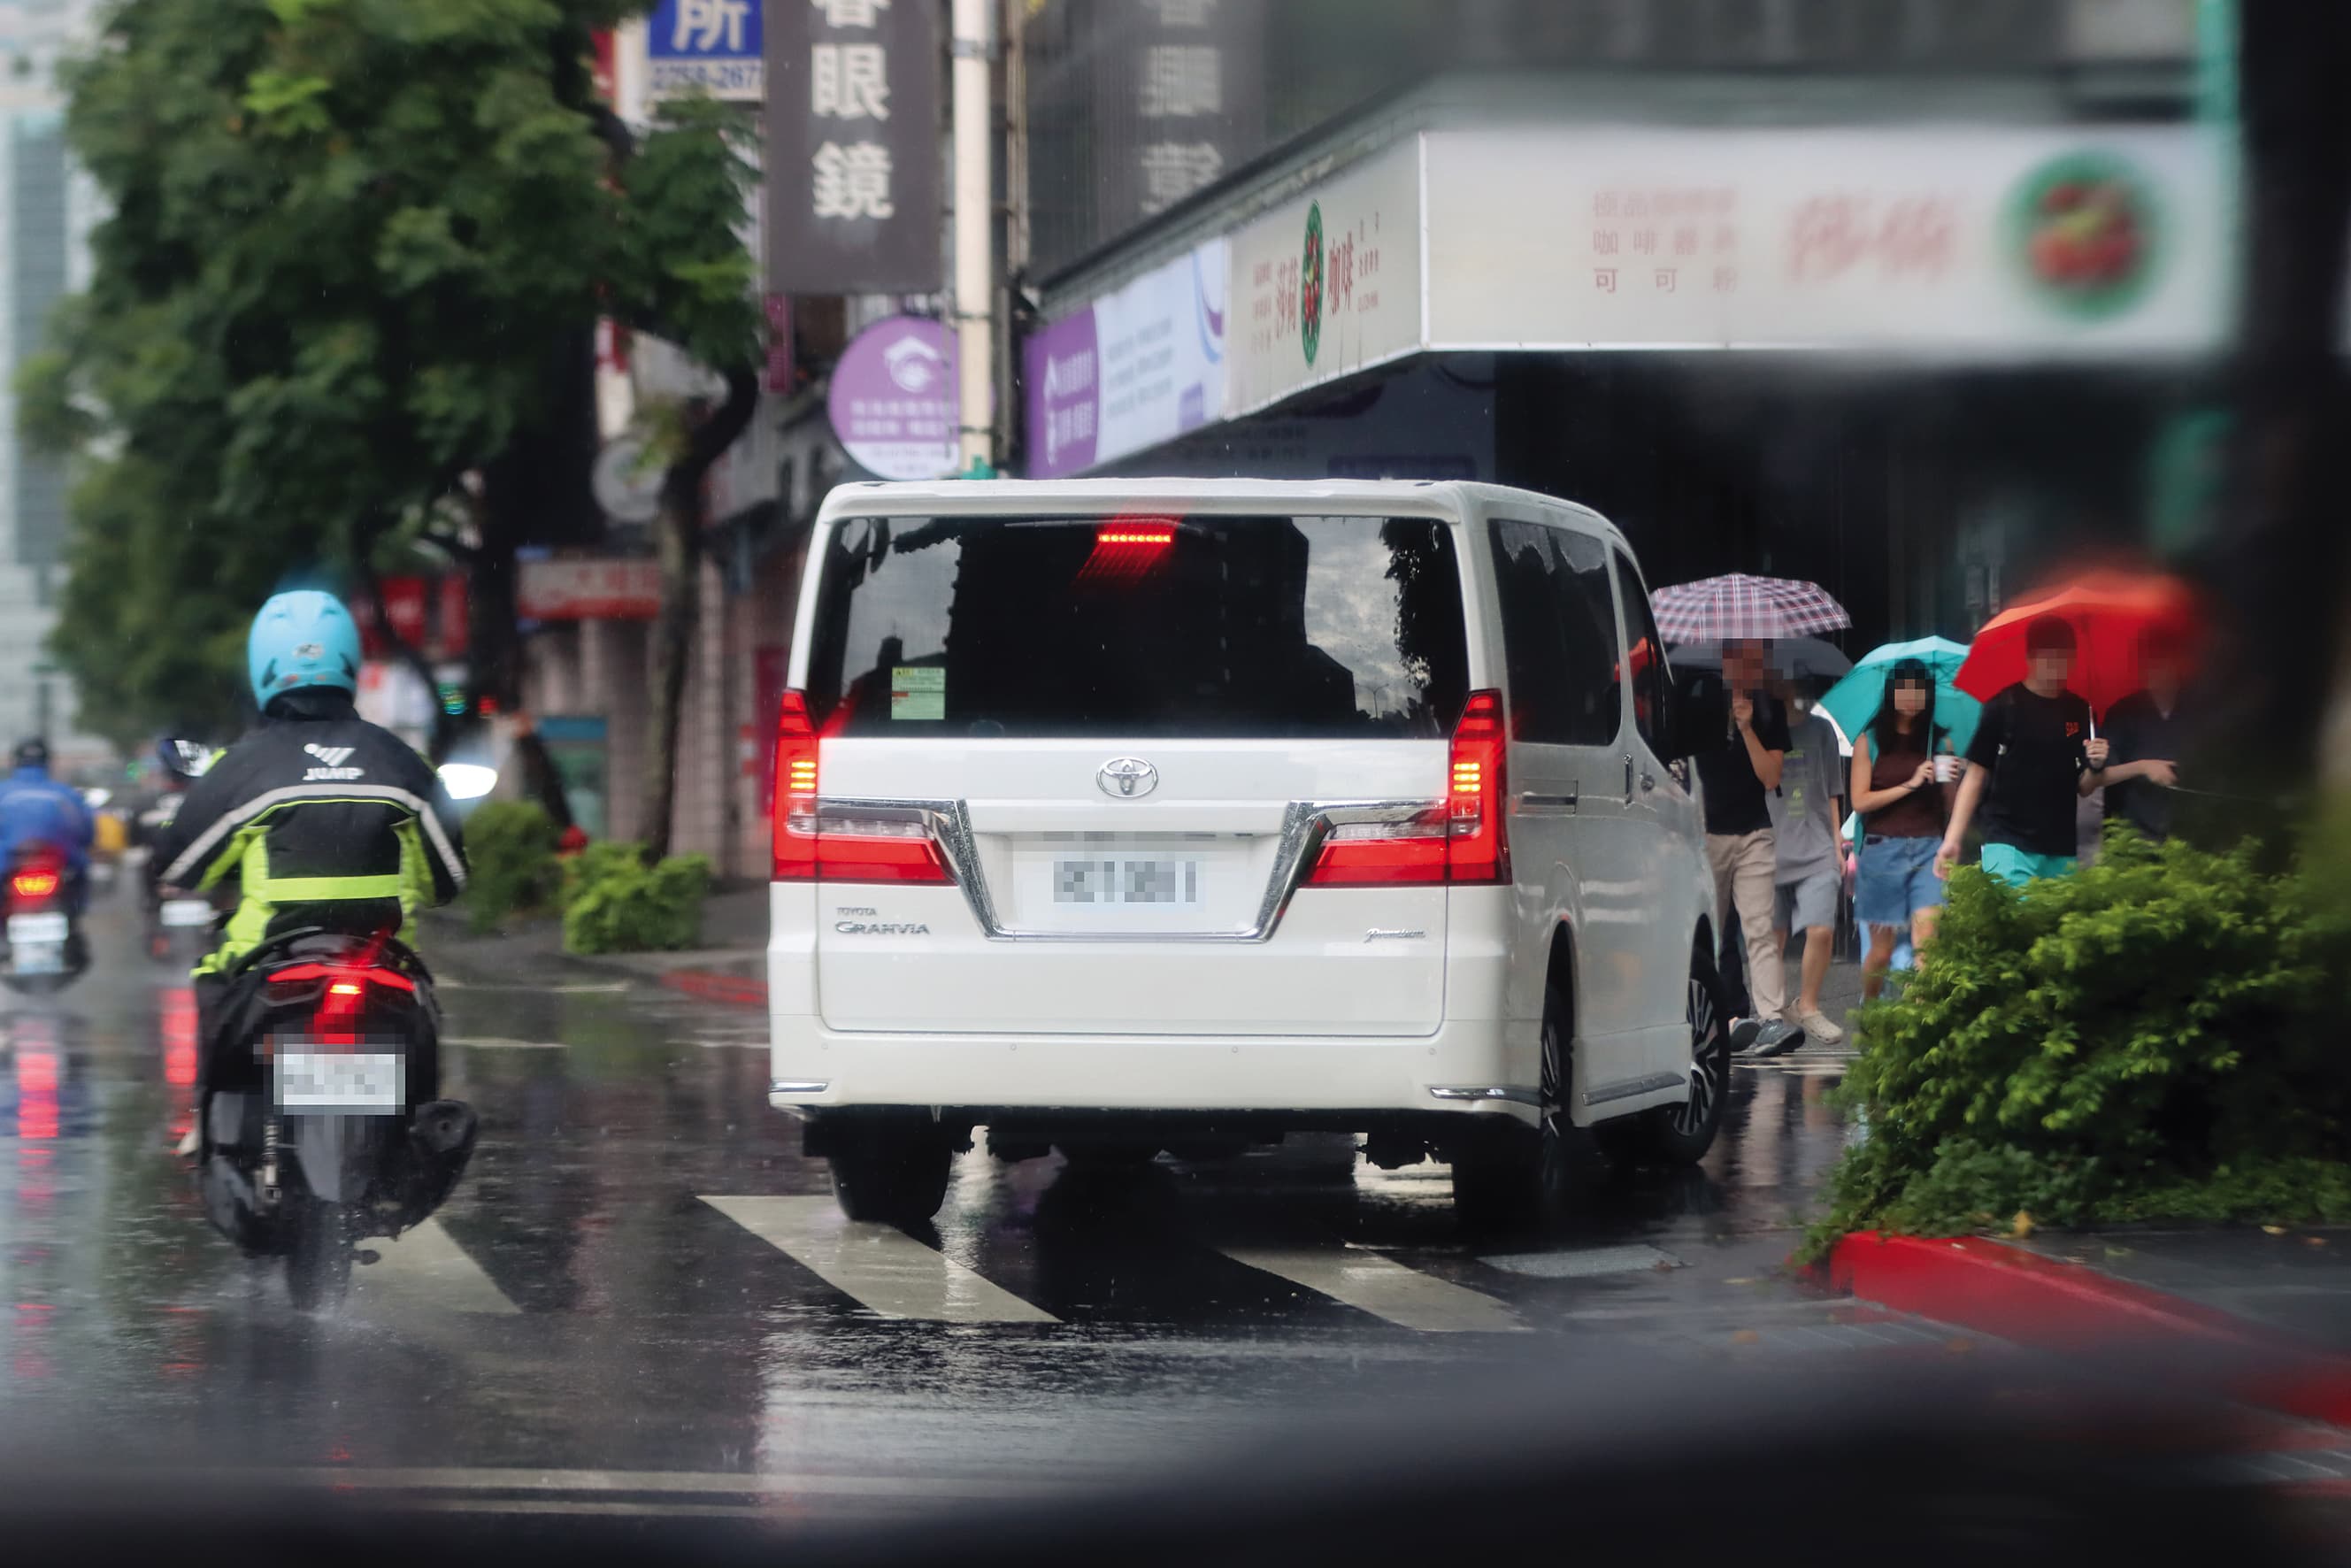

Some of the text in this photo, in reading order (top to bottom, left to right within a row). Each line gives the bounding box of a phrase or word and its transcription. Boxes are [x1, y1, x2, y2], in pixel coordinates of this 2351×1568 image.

[302, 766, 365, 781] JUMP
[835, 906, 877, 917] TOYOTA
[834, 920, 931, 935] GRANVIA
